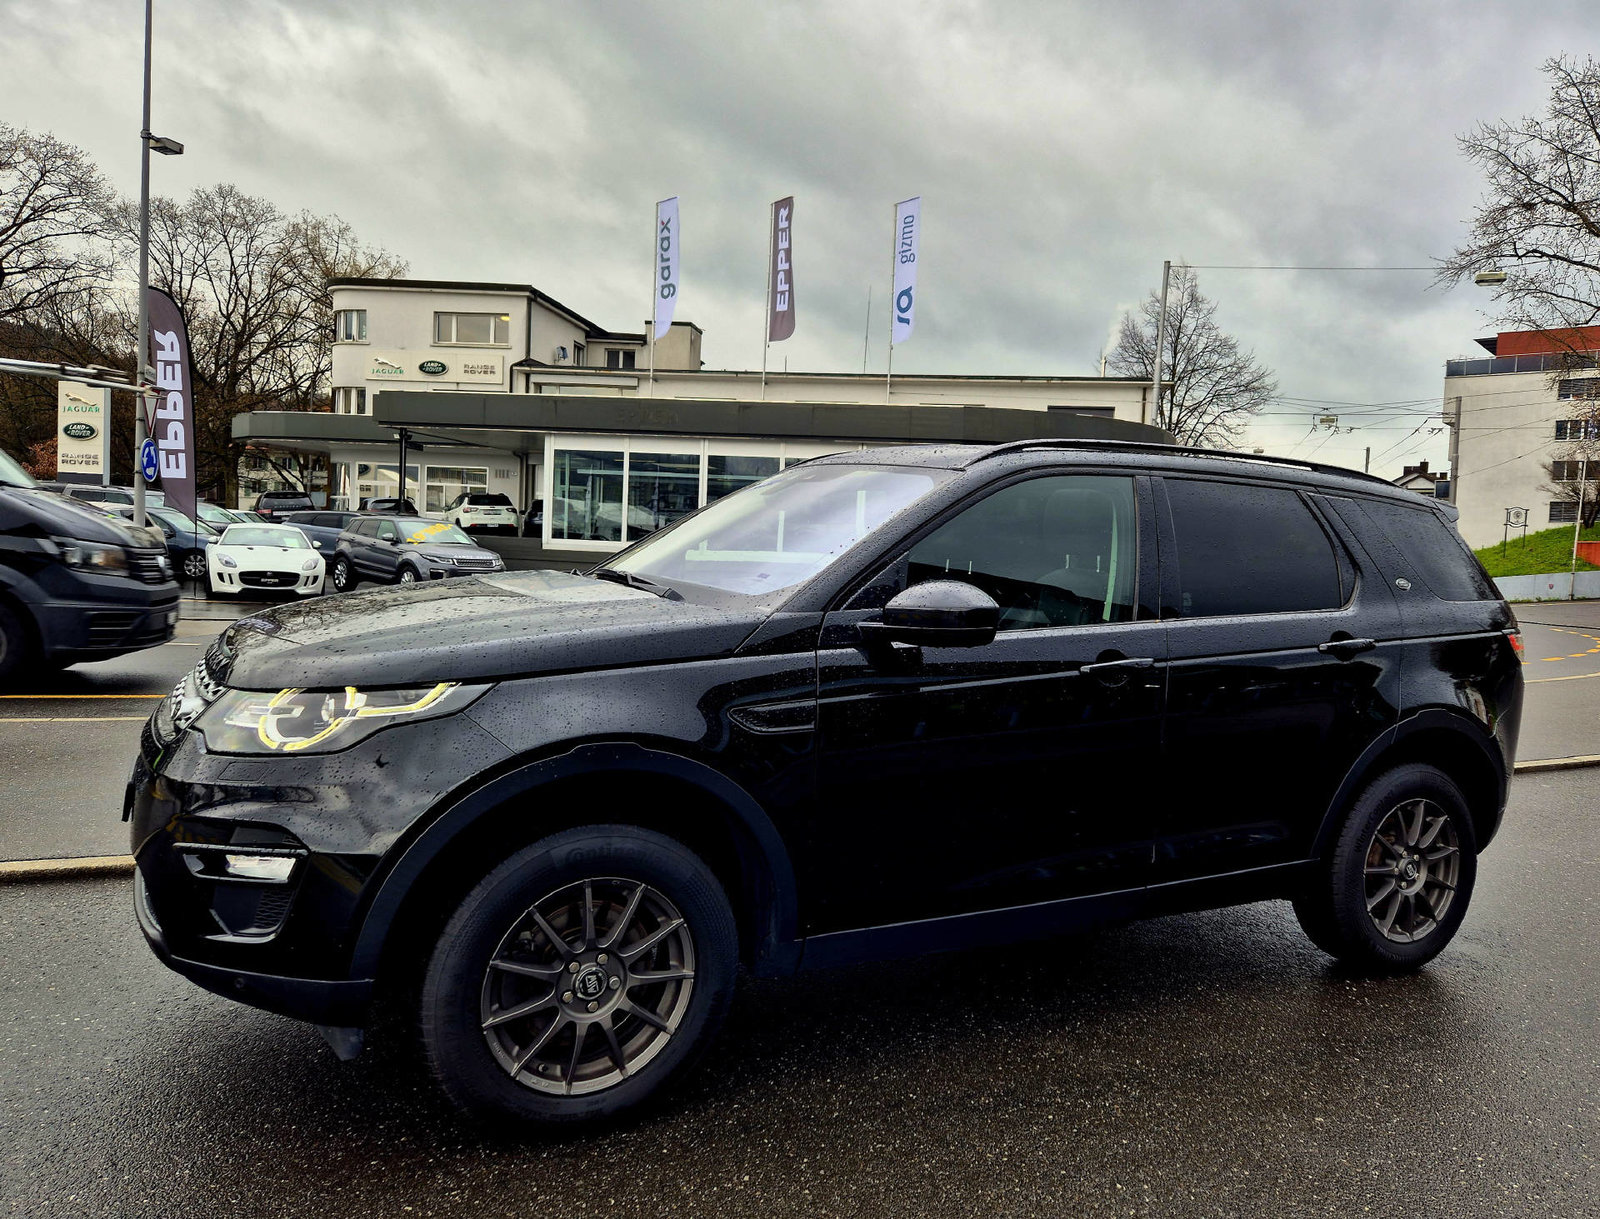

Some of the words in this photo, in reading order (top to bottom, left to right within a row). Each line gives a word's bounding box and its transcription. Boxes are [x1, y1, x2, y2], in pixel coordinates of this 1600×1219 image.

[660, 217, 677, 300] garax
[775, 205, 790, 312] EPPER
[900, 214, 915, 264] gizmo
[62, 405, 100, 413] JAGUAR
